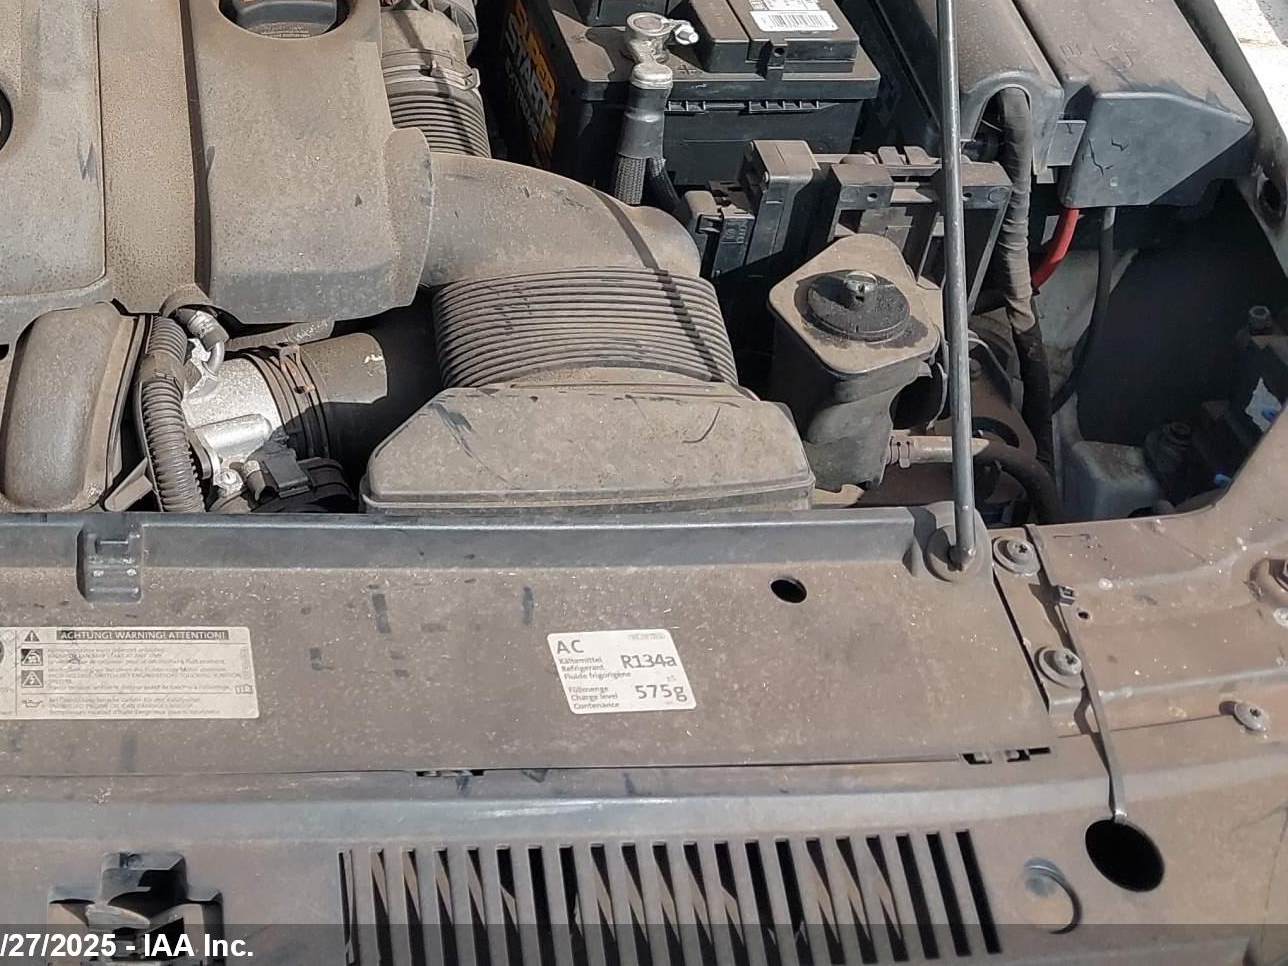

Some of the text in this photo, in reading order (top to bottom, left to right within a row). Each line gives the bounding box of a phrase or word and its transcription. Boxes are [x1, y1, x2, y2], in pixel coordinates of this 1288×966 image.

[60, 630, 225, 640] ACHTUNG! WARNING! ATTENTION!
[556, 639, 584, 654] AC
[620, 653, 677, 669] R134a
